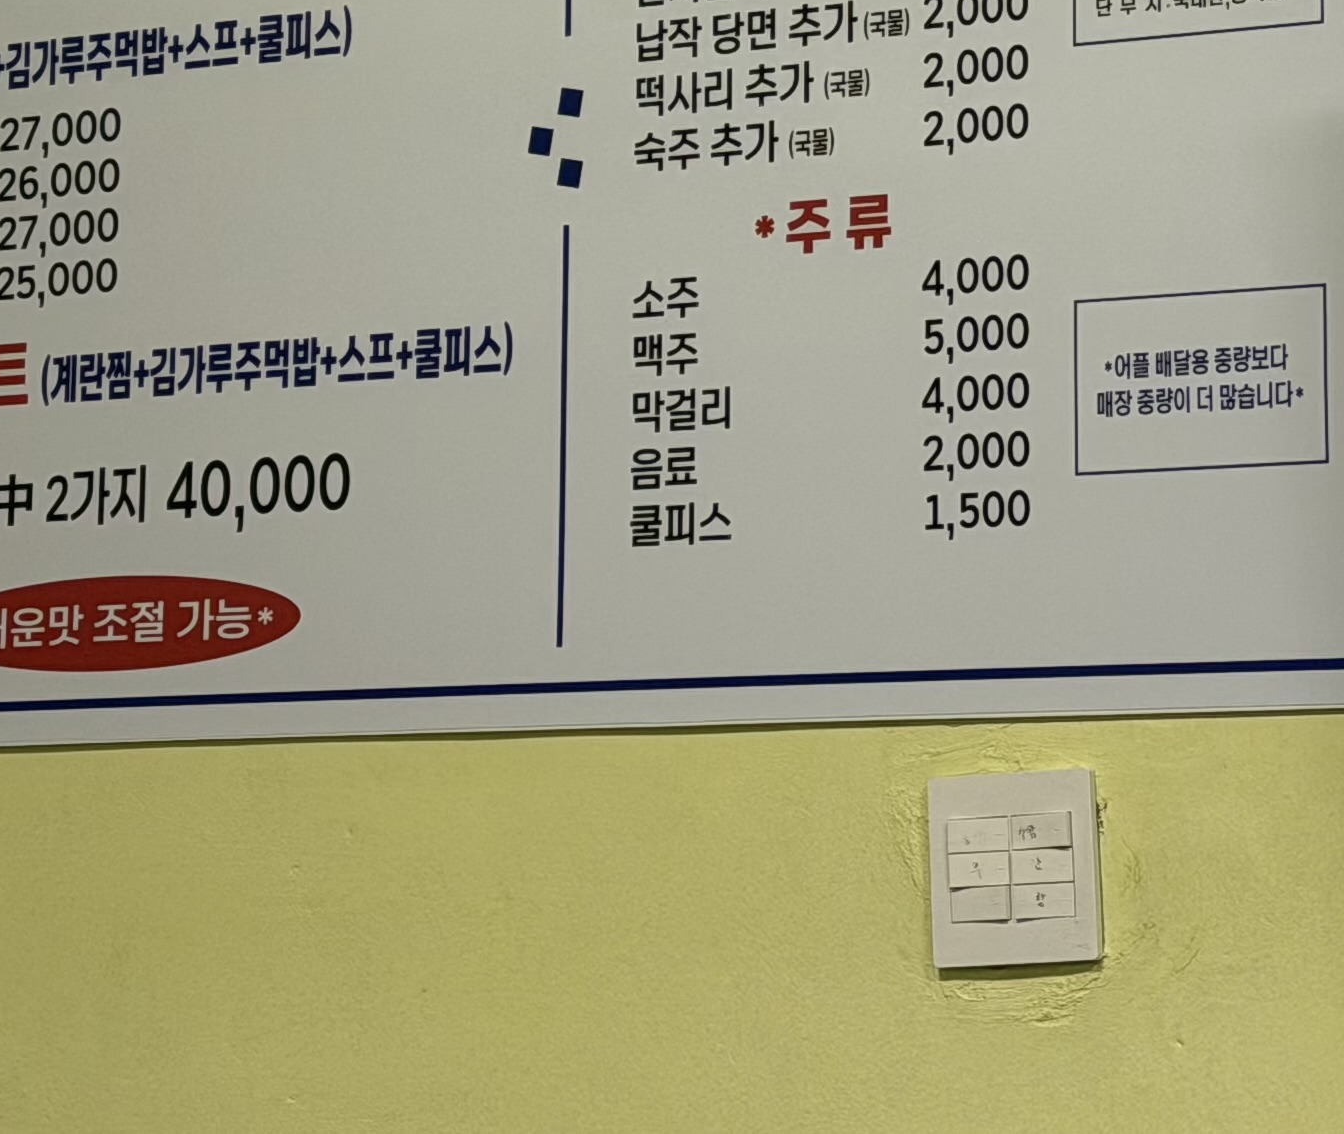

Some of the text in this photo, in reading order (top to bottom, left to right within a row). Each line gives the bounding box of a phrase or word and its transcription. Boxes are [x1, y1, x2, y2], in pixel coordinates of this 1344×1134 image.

[637, 16, 702, 62] 납작
[713, 8, 776, 54] 당면
[789, 0, 858, 46] 추가
[864, 8, 909, 40] (국물)
[636, 45, 1028, 116] 떡사리 추가 (국물) 2,000
[0, 108, 121, 158] 27,000
[634, 103, 1028, 171] 숙주 추가 (국물) 2,000
[633, 254, 1029, 318] 소주 4,000
[634, 313, 1029, 376] 맥주 5,000
[1156, 349, 1209, 377] 배달용
[1215, 344, 1288, 373] 중량보다
[633, 373, 1029, 432] 막걸리 4,000
[1097, 390, 1132, 417] 매장
[1137, 386, 1190, 415] 중량이
[1197, 385, 1213, 412] 더
[631, 431, 1029, 490] 음료 2,000
[46, 465, 146, 525] 2가지
[167, 453, 350, 532] 40,000
[630, 490, 1030, 547] 쿨피스 1,500
[92, 601, 168, 644] 조절
